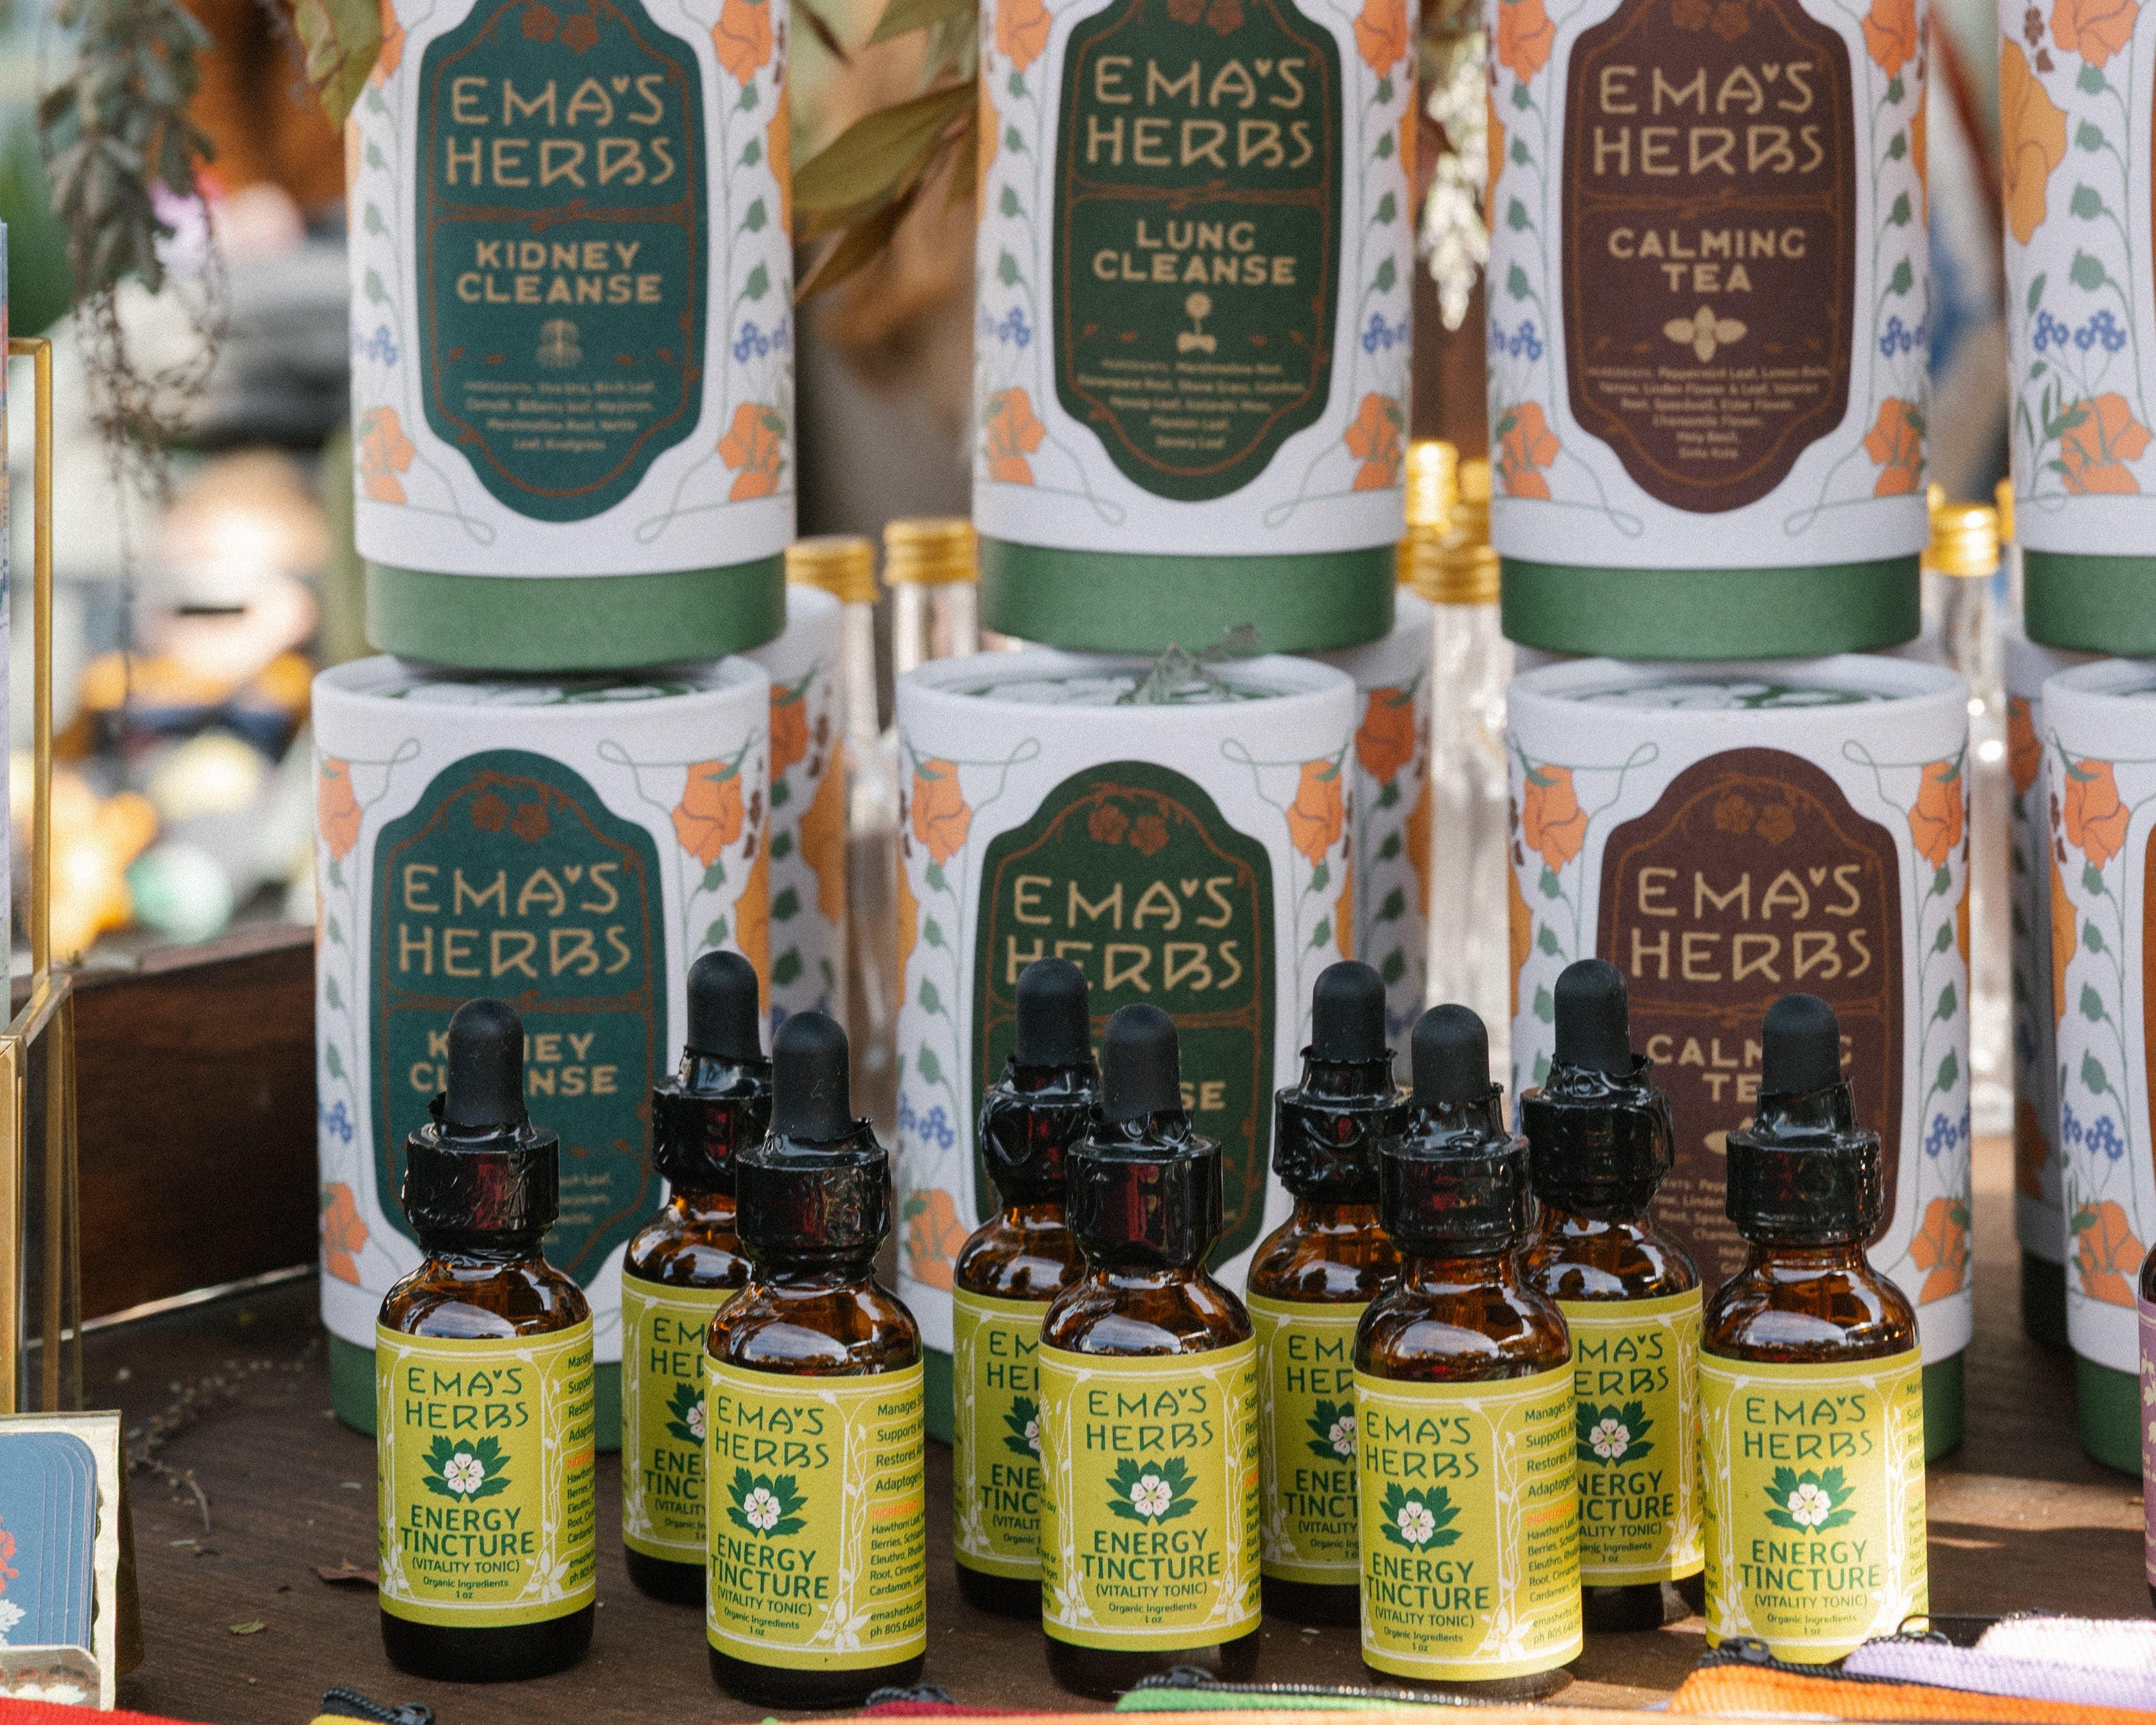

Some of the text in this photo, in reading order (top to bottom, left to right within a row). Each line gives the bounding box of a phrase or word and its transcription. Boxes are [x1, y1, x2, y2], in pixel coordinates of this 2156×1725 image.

[1095, 55, 1306, 109] EMA'S
[1600, 61, 1814, 114] EMA'S
[452, 75, 664, 127] EMA'S
[1086, 115, 1314, 169] HERBS
[1593, 126, 1825, 175] HERBS
[446, 136, 675, 187] HERBS
[1136, 219, 1255, 252] LUNG
[1607, 228, 1807, 258] CALMING
[476, 239, 641, 270] KIDNEY
[1093, 250, 1297, 286] CLEANSE
[457, 274, 663, 304] CLEANSE
[1661, 262, 1753, 292] TEA
[404, 862, 620, 917] EMA'S
[1013, 875, 1234, 932] EMA'S
[1637, 864, 1862, 921] EMA'S
[398, 923, 632, 979] HERBS
[1630, 927, 1871, 983] HERBS
[428, 1029, 595, 1063] KEY
[410, 1061, 617, 1096] CLNSE
[1702, 1072, 1763, 1103] TE
[1578, 1332, 1664, 1364] MA'S
[408, 1366, 522, 1398] EMA'S
[1574, 1365, 1669, 1397] ERBS
[405, 1400, 529, 1430] HERBS
[717, 1394, 825, 1436] EMA'S
[877, 1397, 916, 1417] Manages
[1088, 1385, 1207, 1418] EMA'S
[1525, 1402, 1566, 1422] Manages
[1746, 1394, 1865, 1426] EMA'S
[877, 1423, 916, 1443] Supports
[1087, 1420, 1214, 1451] HERBS
[1366, 1410, 1471, 1445] EMA'S
[1526, 1426, 1566, 1448] Supports
[715, 1426, 830, 1469] HERBS
[876, 1448, 916, 1467] Restores
[1744, 1430, 1871, 1461] HERBS
[654, 1448, 703, 1476] ENE
[991, 1463, 1040, 1490] ENE
[1366, 1444, 1479, 1479] HERBS
[1527, 1451, 1566, 1472] Restores
[644, 1469, 705, 1500] TINC
[1577, 1469, 1663, 1496] NERGY
[980, 1485, 1039, 1515] TINC
[1283, 1492, 1358, 1518] TINCT
[1578, 1493, 1674, 1522] CTURE
[411, 1504, 522, 1531] ENERGY
[1579, 1524, 1616, 1538] ALITY
[400, 1526, 535, 1557] TINCTURE
[717, 1534, 816, 1573] ENERGY
[871, 1537, 902, 1550] Berries,
[1094, 1527, 1208, 1554] ENERGY
[1604, 1542, 1652, 1554] Ingredients
[1752, 1539, 1867, 1566] ENERGY
[412, 1556, 520, 1573] (VITALITY TONIC)
[870, 1552, 907, 1566] Eleuthro,
[1081, 1551, 1221, 1581] TINCTURE
[1372, 1551, 1474, 1584] ENERGY
[423, 1577, 509, 1591] Organic Ingredients
[710, 1554, 830, 1600] TINCTURE
[870, 1569, 893, 1581] Root,
[1096, 1581, 1207, 1598] (VITALITY TONIC)
[1529, 1573, 1551, 1588] Root,
[1740, 1564, 1881, 1591] TINCTURE
[462, 1591, 473, 1599] oz
[717, 1585, 813, 1618] (VITALITY TONIC)
[1109, 1600, 1197, 1614] Organic Ingredients
[1366, 1576, 1490, 1610] TINCTURE
[1822, 1593, 1867, 1608] TONIC)
[724, 1606, 800, 1631] Organic Ingredients
[1152, 1615, 1162, 1624] oz
[1375, 1605, 1474, 1628] (VITALITY TONIC)
[755, 1628, 765, 1637] oz
[870, 1625, 882, 1639] ph
[1384, 1627, 1463, 1644] Organic Ingredients
[1533, 1632, 1545, 1646] ph
[1418, 1644, 1428, 1652] oz
